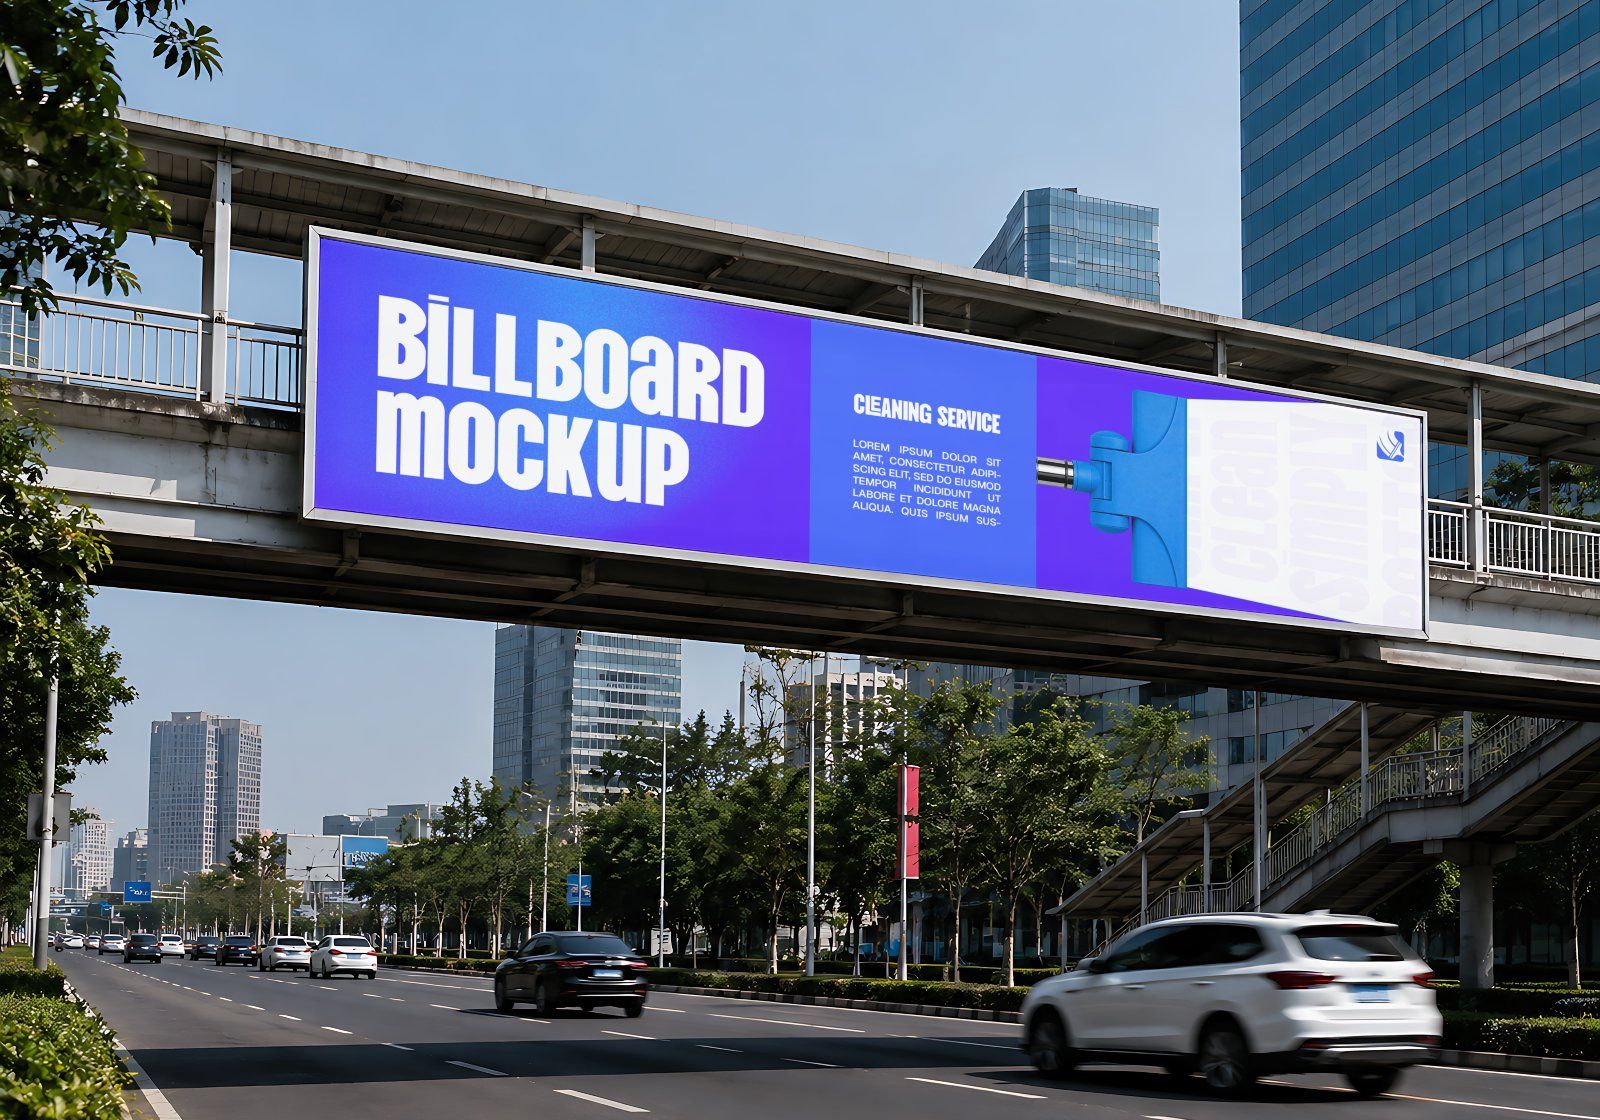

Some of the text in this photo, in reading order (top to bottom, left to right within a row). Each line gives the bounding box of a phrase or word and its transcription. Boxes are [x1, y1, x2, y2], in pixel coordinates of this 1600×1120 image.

[853, 393, 1000, 434] CLEANING SERVICE
[853, 439, 1001, 467] LOREM IPSUM DOLOR SIT
[853, 452, 1001, 478] AMET, CONSECTETUR ADIPI-
[853, 465, 1001, 491] SCING ELIT, SED DO EIUSMOD
[853, 476, 1001, 502] TEMPOR INCIDIDUNT UT
[853, 489, 1000, 514] LABORE ET DOLORE MAGNA
[853, 501, 1000, 526] ALIQUA. QUIS IPSUM SUS-
